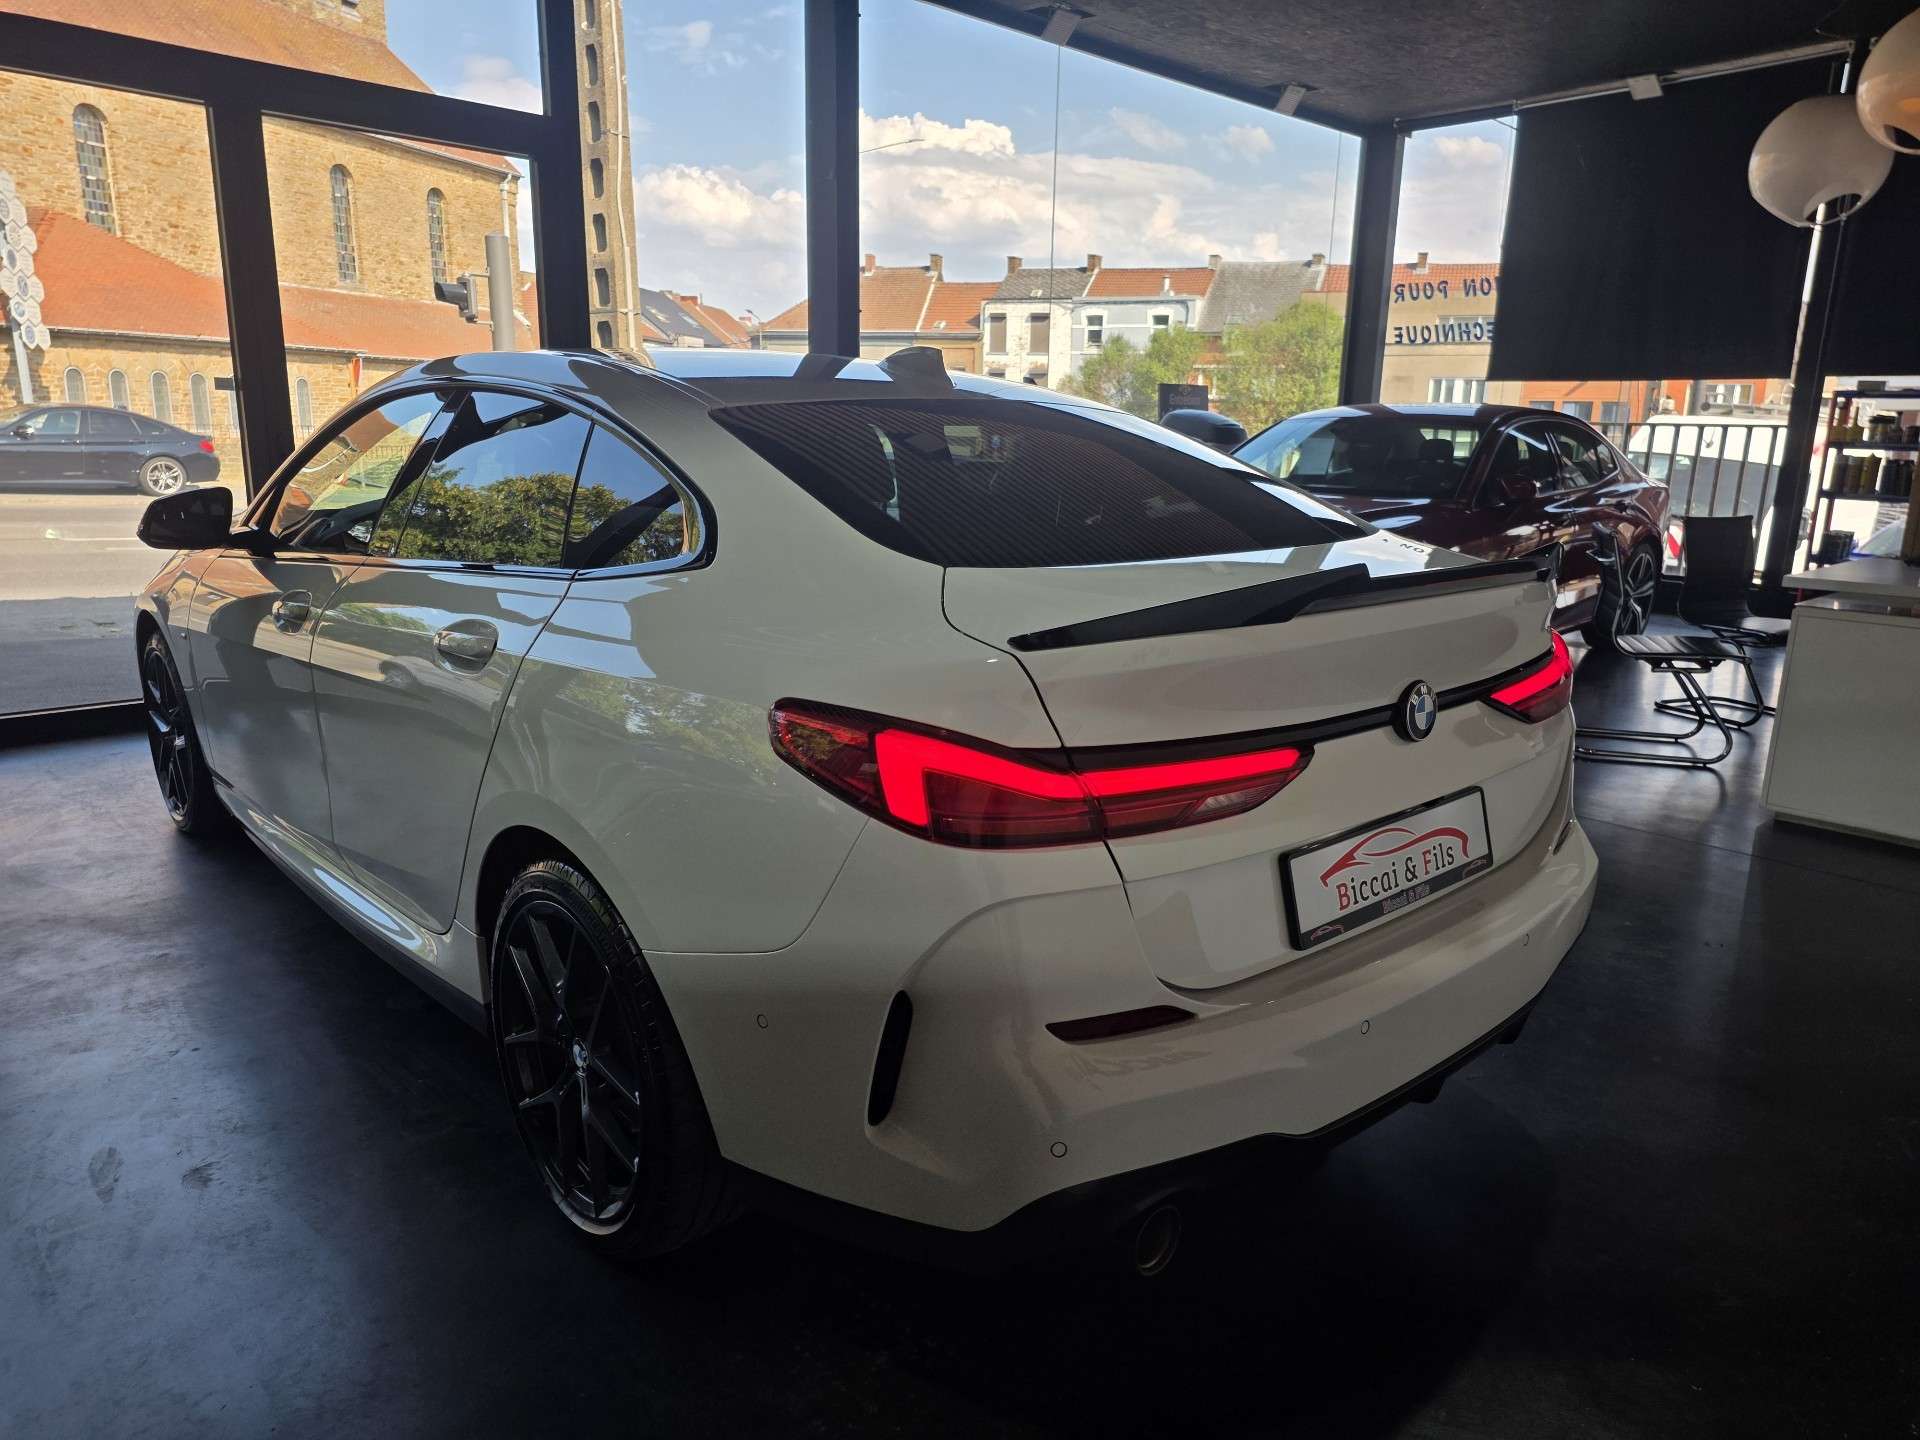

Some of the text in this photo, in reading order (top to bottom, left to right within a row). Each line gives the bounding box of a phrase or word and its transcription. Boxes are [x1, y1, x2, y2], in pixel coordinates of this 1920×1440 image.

[1335, 862, 1400, 911] Biccai
[1404, 856, 1418, 882] &
[1423, 843, 1455, 875] Fils
